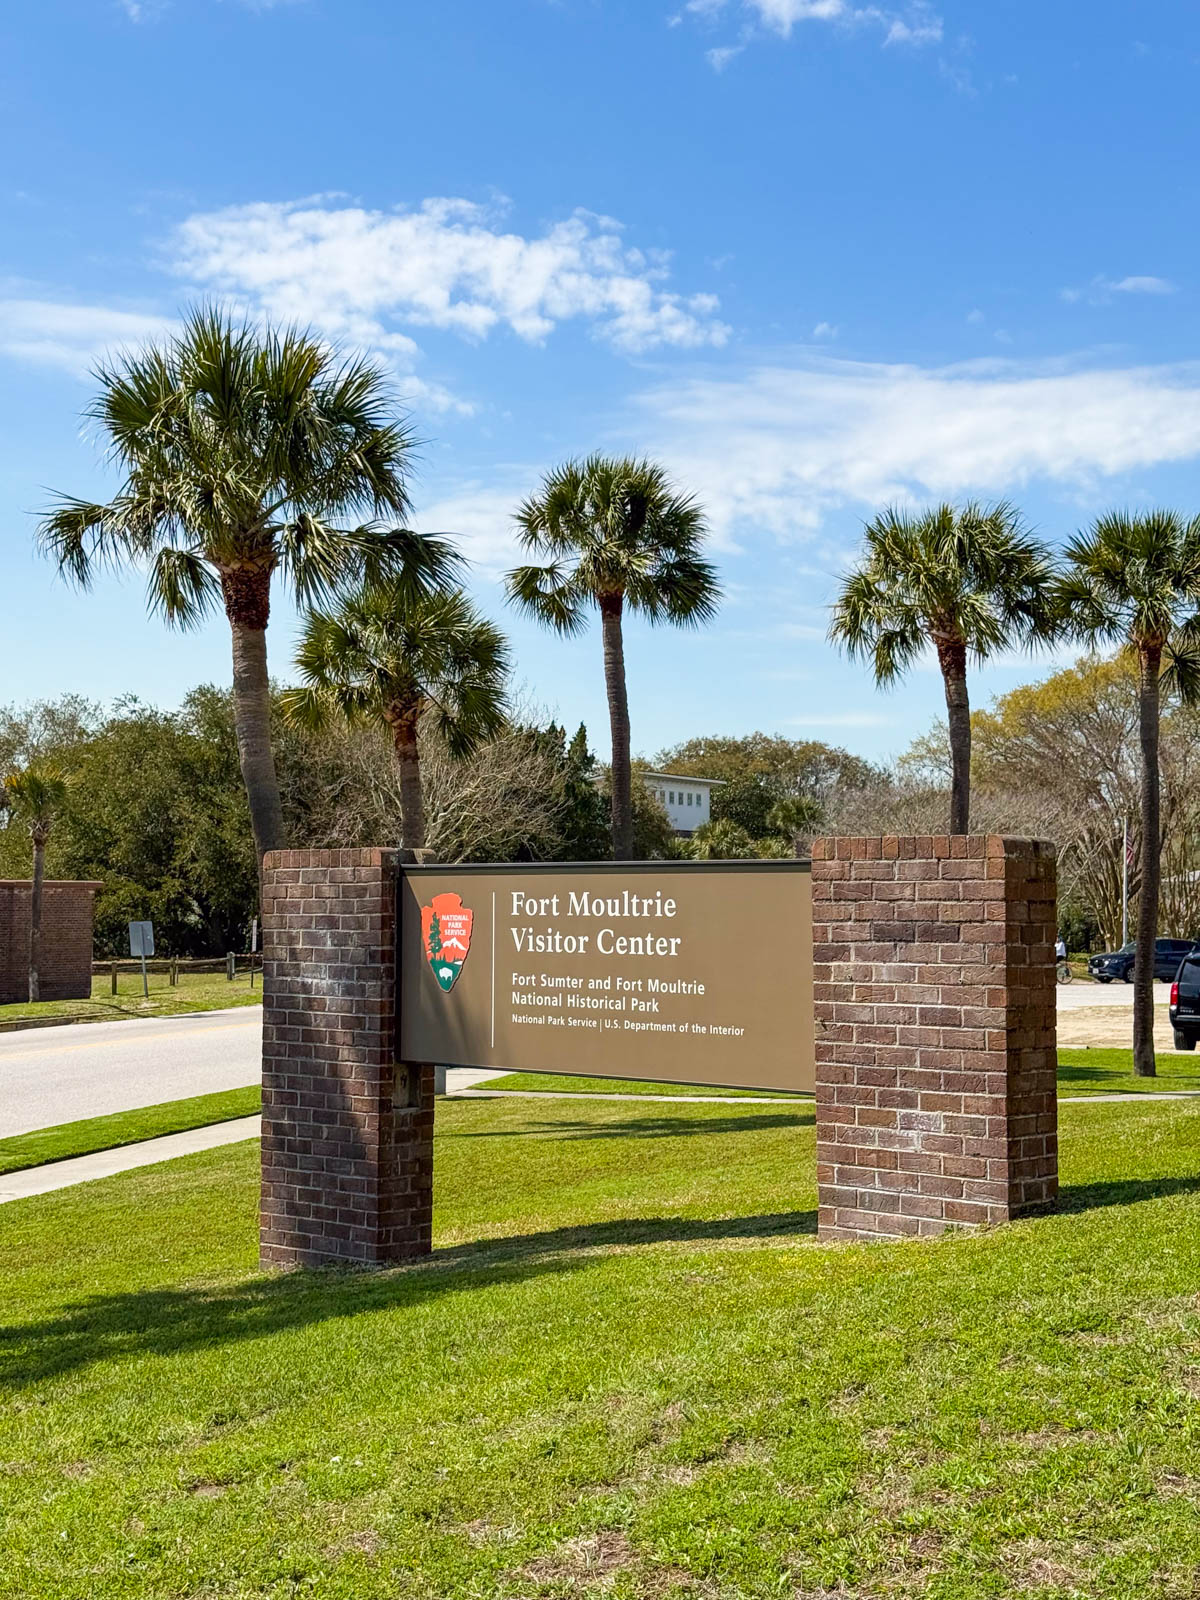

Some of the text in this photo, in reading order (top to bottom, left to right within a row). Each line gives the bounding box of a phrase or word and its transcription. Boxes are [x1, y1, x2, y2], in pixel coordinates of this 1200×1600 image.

[511, 890, 677, 918] Fort Moultrie
[510, 927, 682, 956] Visitor Center
[512, 972, 705, 995] Fort Sumter and Fort Moultrie
[512, 991, 660, 1013] National Historical Park
[511, 1013, 745, 1036] National Park Service U.S. Department of the Interior
